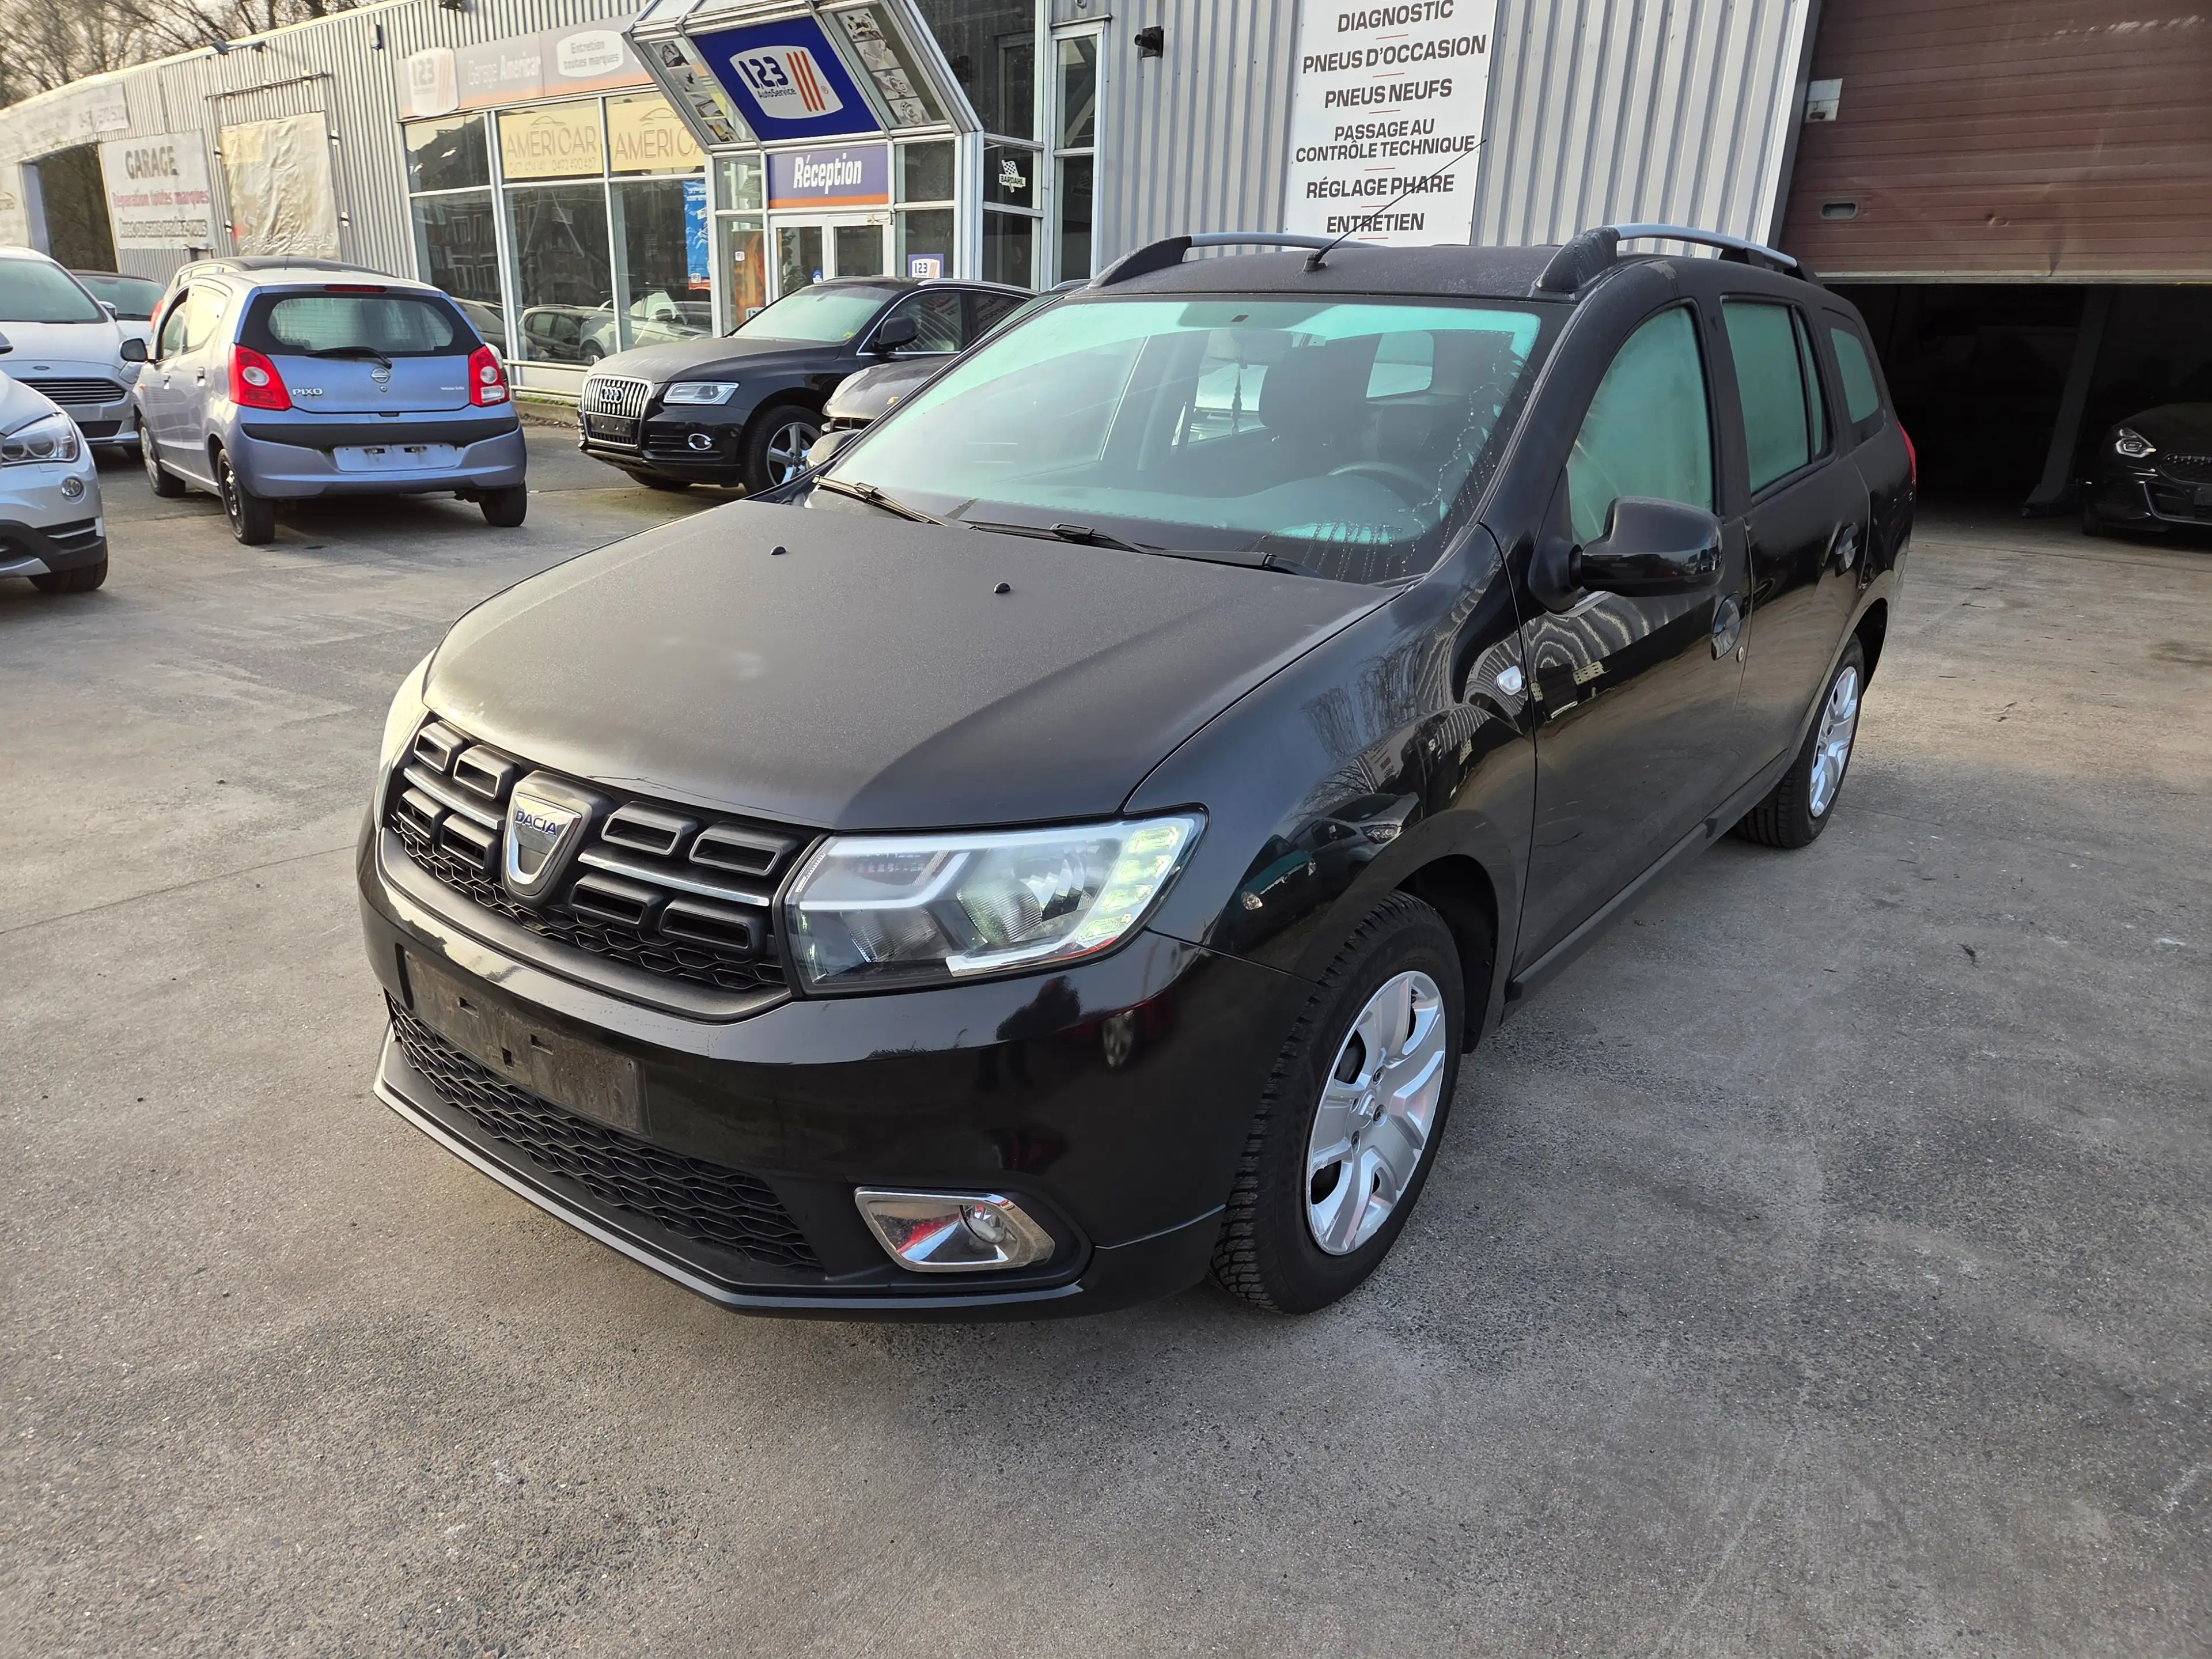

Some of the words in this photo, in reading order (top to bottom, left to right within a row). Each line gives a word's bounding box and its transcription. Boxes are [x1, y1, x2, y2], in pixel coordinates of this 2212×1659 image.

[1338, 0, 1454, 32] DIAGNOSTIC
[571, 39, 605, 54] Entretien
[1303, 50, 1362, 74] PNEUS
[1366, 35, 1487, 67] D'OCCASION
[757, 87, 797, 99] AutoService
[1325, 85, 1385, 108] PNEUS
[1389, 78, 1453, 103] NEUFS
[1334, 120, 1409, 141] PASSAGE
[1411, 119, 1435, 135] AU
[1296, 139, 1378, 162] CONTRÔLE
[1380, 135, 1475, 157] TECHNIQUE
[125, 145, 179, 180] GARAGE
[793, 153, 862, 194] Réception
[1306, 176, 1388, 199] RÉGLAGE
[1391, 175, 1455, 195] PHARE
[1327, 213, 1425, 233] ENTRETIEN
[914, 263, 927, 274] 123
[292, 388, 323, 396] PIXO
[515, 810, 557, 837] DACIA
